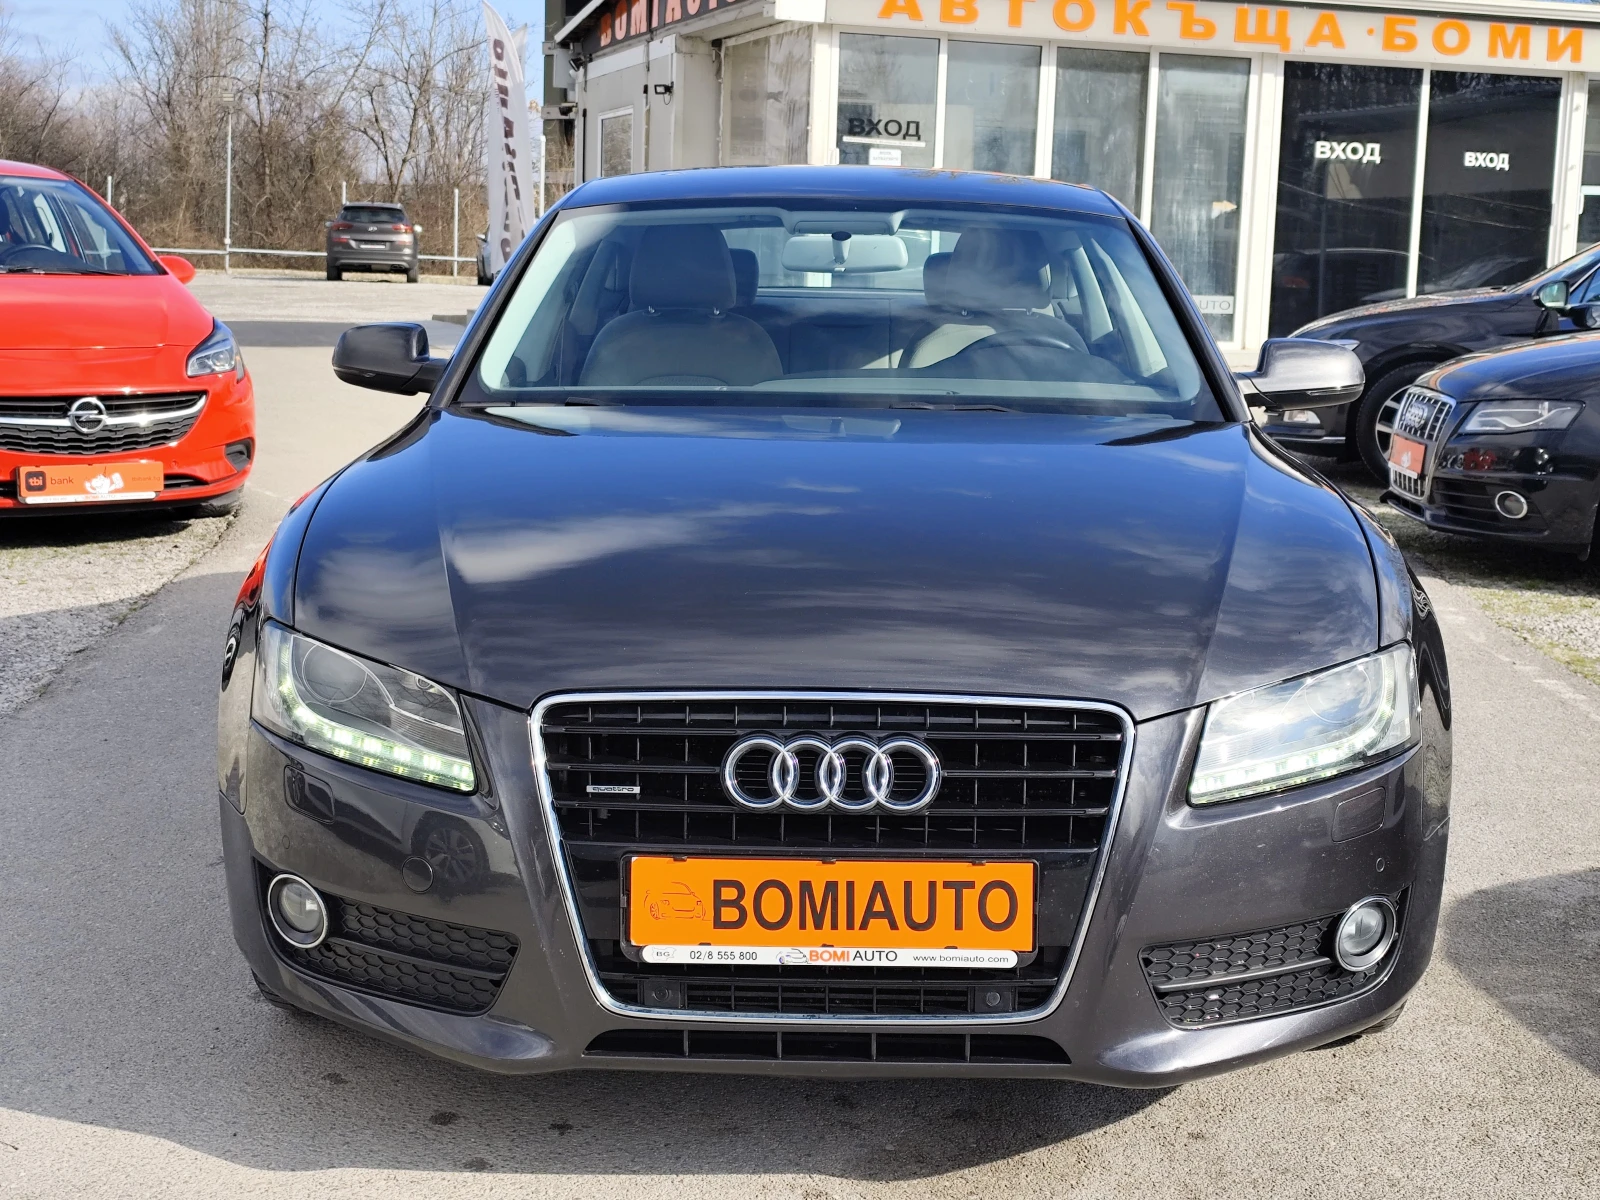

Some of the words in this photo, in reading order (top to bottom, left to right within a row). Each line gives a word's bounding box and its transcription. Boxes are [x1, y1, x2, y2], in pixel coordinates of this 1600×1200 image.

[877, 0, 1346, 52] АВТОКЪЩА
[1382, 15, 1584, 63] БОМИ
[847, 118, 921, 141] ВХОД
[1315, 140, 1381, 164] ВХОД
[1464, 151, 1509, 171] ВХОД
[1199, 300, 1231, 311] UTO
[28, 476, 43, 487] tbi
[50, 476, 75, 485] bank
[712, 879, 1019, 932] BOMIAUTO
[689, 950, 714, 961] 02/8
[717, 951, 736, 960] 555
[738, 951, 758, 961] 800
[809, 949, 850, 962] BOMI
[852, 950, 898, 962] AUTO
[912, 954, 1009, 963] www.bomiauto.com
